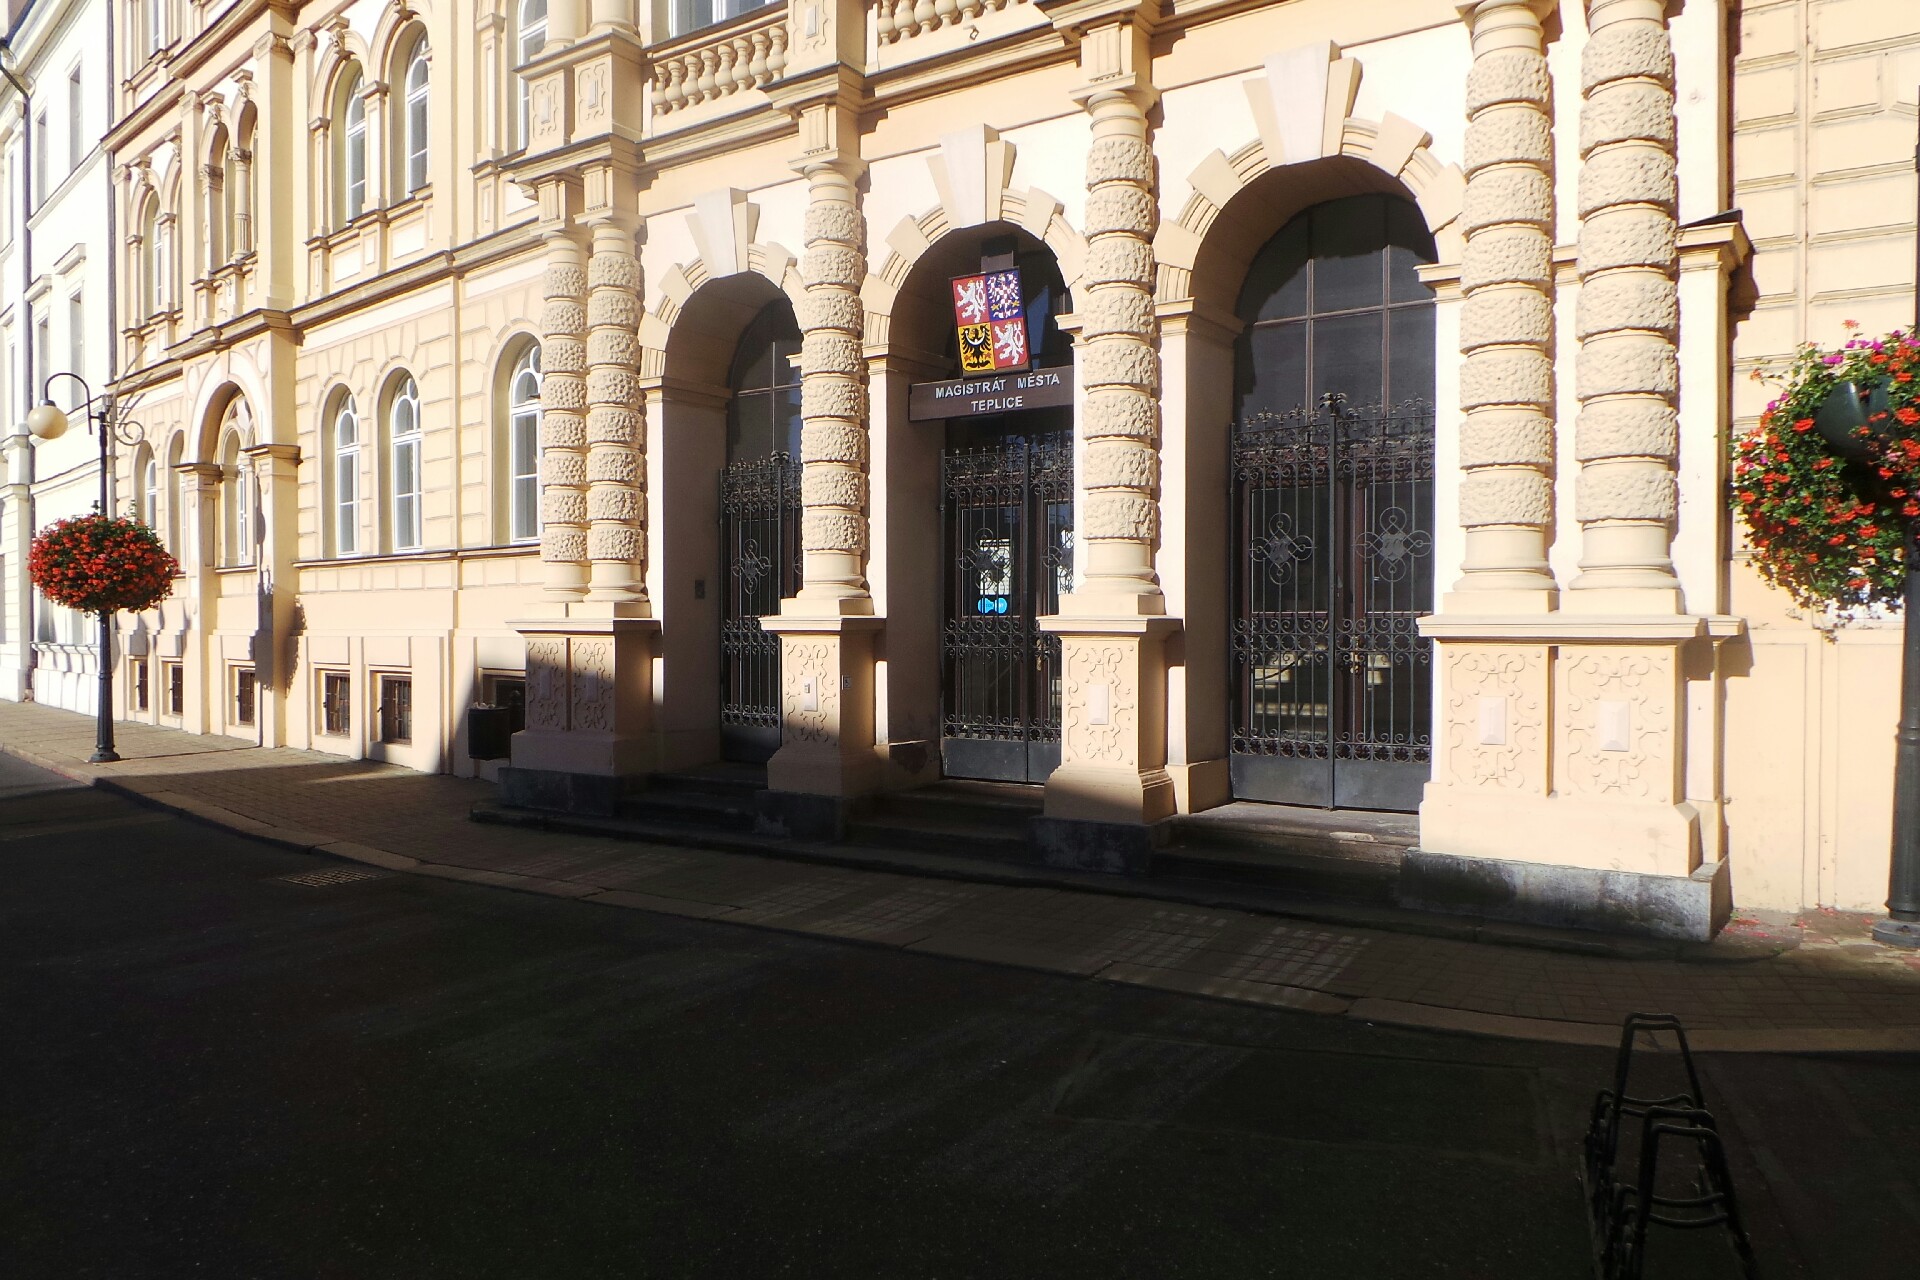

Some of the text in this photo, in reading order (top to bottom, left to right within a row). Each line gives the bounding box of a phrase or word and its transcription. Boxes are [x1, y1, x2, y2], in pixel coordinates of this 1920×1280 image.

[935, 373, 1060, 398] MAGISTRÁT MĚSTA
[971, 396, 1023, 412] TEPLICE
